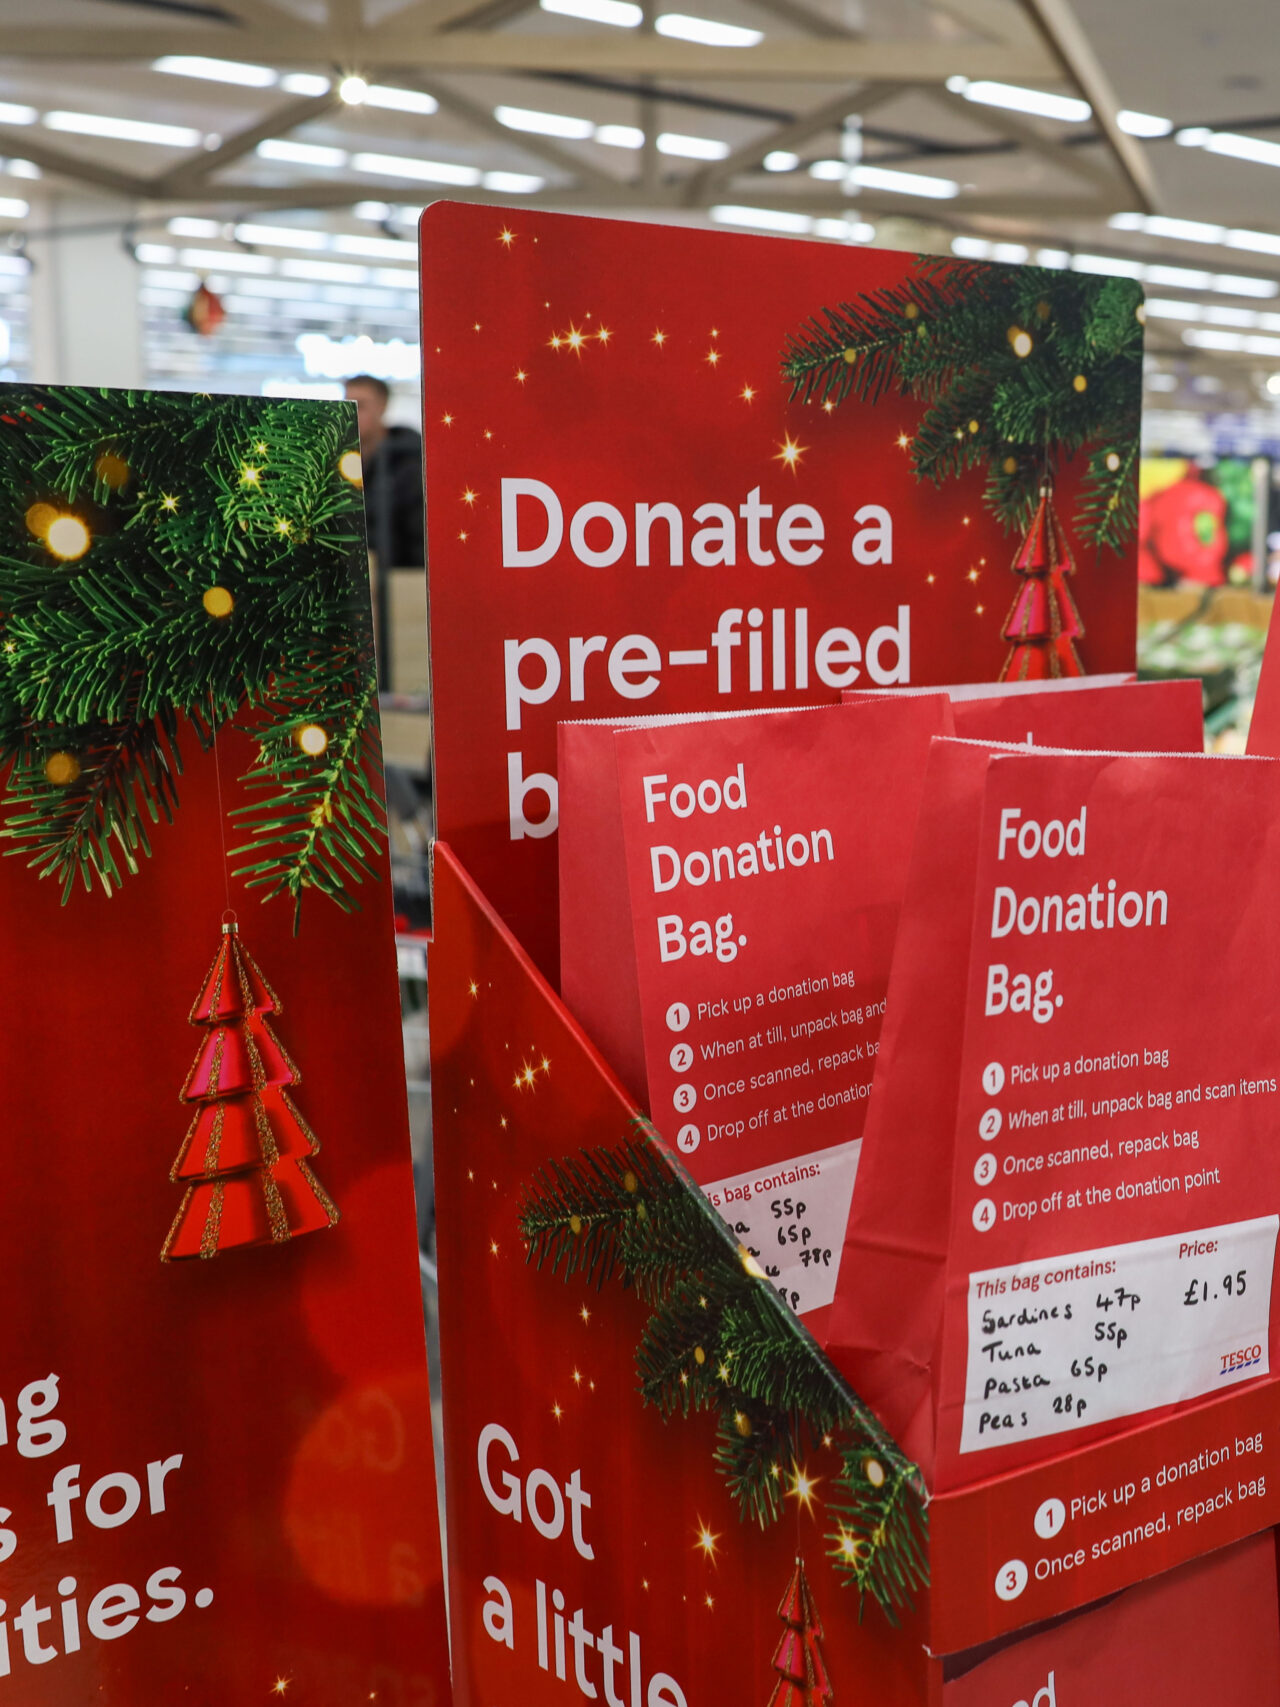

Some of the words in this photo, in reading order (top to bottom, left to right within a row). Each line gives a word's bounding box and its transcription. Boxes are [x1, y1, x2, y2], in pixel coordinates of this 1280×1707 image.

[501, 477, 825, 568] Donate
[851, 504, 893, 565] a
[504, 605, 910, 731] pre-filled
[643, 763, 747, 823] Food
[650, 825, 834, 893] Donation
[998, 805, 1086, 860] Food
[991, 878, 1168, 938] Donation
[657, 913, 747, 963] Bag.
[697, 998, 729, 1020] Pick
[733, 997, 752, 1014] up
[755, 993, 765, 1007] a
[768, 977, 829, 1003] donation
[832, 970, 855, 987] bag
[985, 963, 1063, 1023] Bag.
[700, 1039, 746, 1061] When
[748, 1033, 763, 1049] at
[766, 1026, 787, 1043] till,
[790, 1011, 838, 1039] unpack
[841, 1007, 864, 1024] bag
[865, 998, 887, 1018] and
[703, 1080, 745, 1101] Once
[750, 1058, 814, 1090] scanned,
[817, 1045, 864, 1071] repack
[866, 1041, 880, 1057] ba
[1010, 1064, 1040, 1085] Pick
[1042, 1064, 1060, 1083] up
[1063, 1061, 1071, 1076] a
[1074, 1051, 1139, 1075] donation
[1143, 1048, 1170, 1067] bag
[707, 1119, 745, 1142] Drop
[748, 1110, 769, 1128] off
[773, 1106, 788, 1123] at
[791, 1098, 815, 1117] the
[1008, 1109, 1049, 1130] When
[1051, 1106, 1065, 1122] at
[1067, 1099, 1088, 1120] till,
[1092, 1095, 1144, 1117] unpack
[1147, 1091, 1173, 1111] bag
[1175, 1084, 1201, 1104] and
[1205, 1082, 1236, 1100] scan
[1239, 1077, 1277, 1095] items
[1002, 1155, 1044, 1176] Once
[1047, 1140, 1114, 1167] scanned,
[1118, 1132, 1170, 1155] repack
[1173, 1129, 1200, 1149] bag
[723, 1184, 752, 1202] bag
[754, 1163, 821, 1194] contains:
[1002, 1200, 1037, 1222] Drop
[1040, 1192, 1063, 1212] off
[1066, 1192, 1082, 1208] at
[1086, 1186, 1112, 1204] the
[1115, 1173, 1180, 1200] donation
[1184, 1167, 1221, 1192] point
[777, 1224, 811, 1246] 65p
[799, 1248, 832, 1267] 78p
[1179, 1239, 1219, 1259] Price:
[976, 1280, 1007, 1299] This
[1011, 1273, 1040, 1293] bag
[1044, 1260, 1117, 1287] contains:
[1184, 1270, 1247, 1306] £1.95
[981, 1304, 1072, 1334] Sardines
[1096, 1288, 1141, 1311] 47p
[982, 1340, 1041, 1363] Tuna
[1094, 1322, 1128, 1348] 55p
[1070, 1356, 1108, 1382] 65p
[1220, 1344, 1262, 1370] TESCO
[1052, 1394, 1087, 1418] 28p
[47, 1454, 183, 1544] for
[477, 1423, 595, 1560] Got
[1070, 1490, 1107, 1520] Pick
[1113, 1482, 1136, 1505] up
[1141, 1476, 1151, 1493] a
[1156, 1443, 1230, 1487] donation
[1235, 1432, 1264, 1457] bag
[1034, 1549, 1086, 1580] Once
[1091, 1512, 1172, 1560] scanned,
[1177, 1486, 1233, 1526] repack
[1237, 1476, 1266, 1500] bag
[0, 1567, 214, 1677] ities.
[482, 1575, 515, 1650] a
